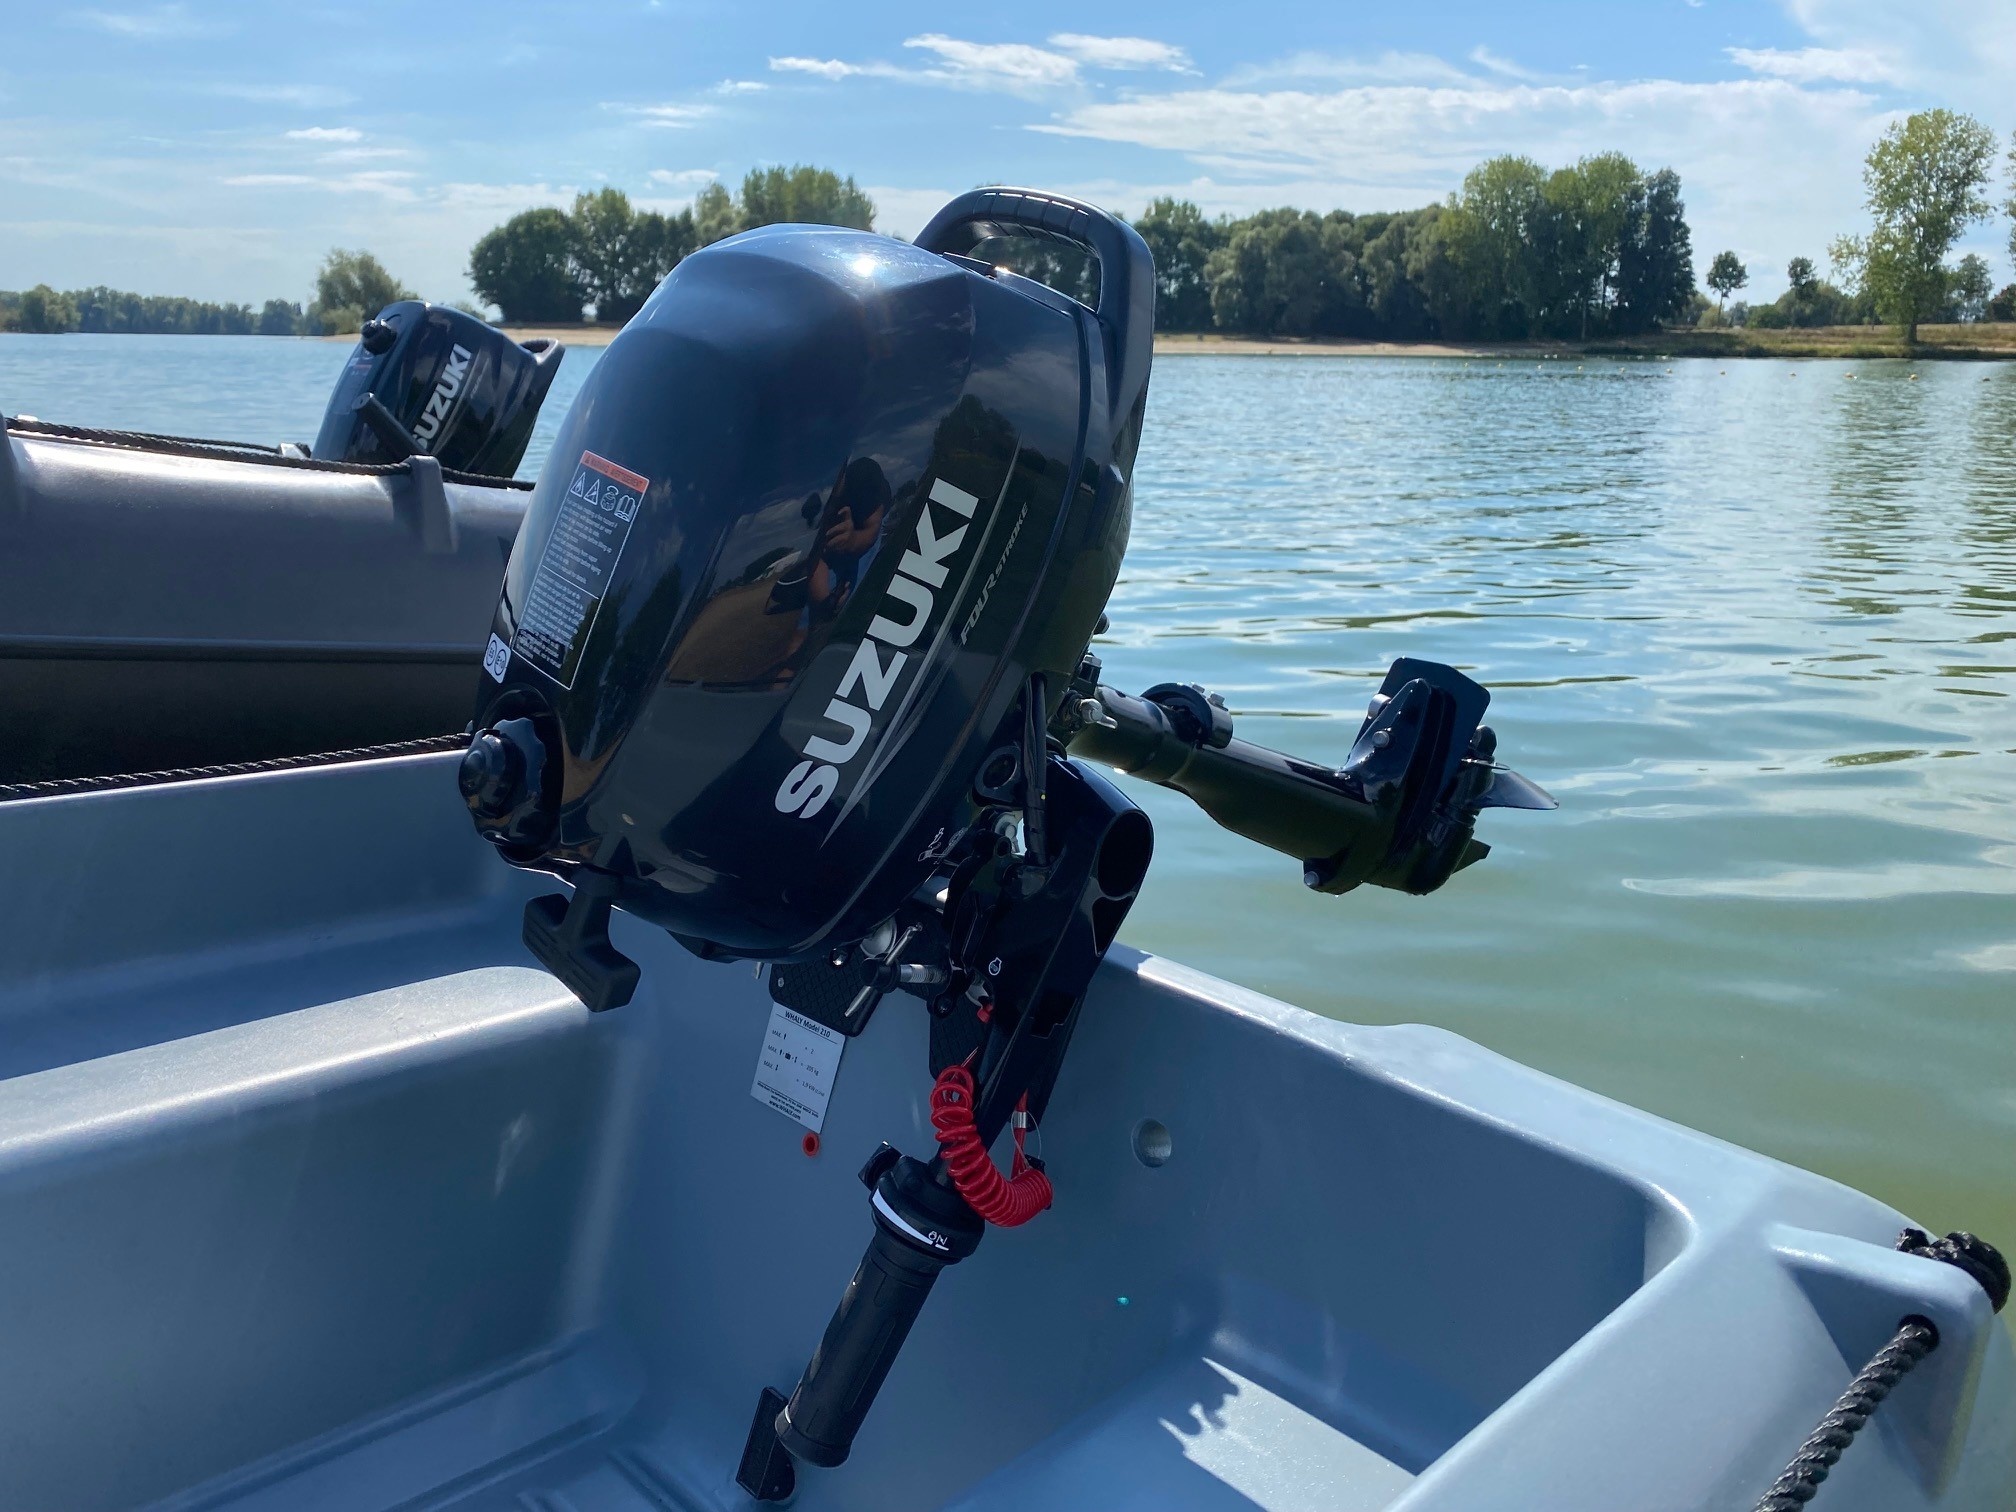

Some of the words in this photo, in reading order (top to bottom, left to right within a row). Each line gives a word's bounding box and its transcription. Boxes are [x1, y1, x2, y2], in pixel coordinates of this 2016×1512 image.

[960, 573, 997, 645] FOUR
[994, 501, 1029, 578] STROKE
[774, 477, 980, 820] SUZUKI
[785, 1011, 804, 1024] WHALY
[803, 1020, 819, 1032] Model
[820, 1027, 831, 1038] 210
